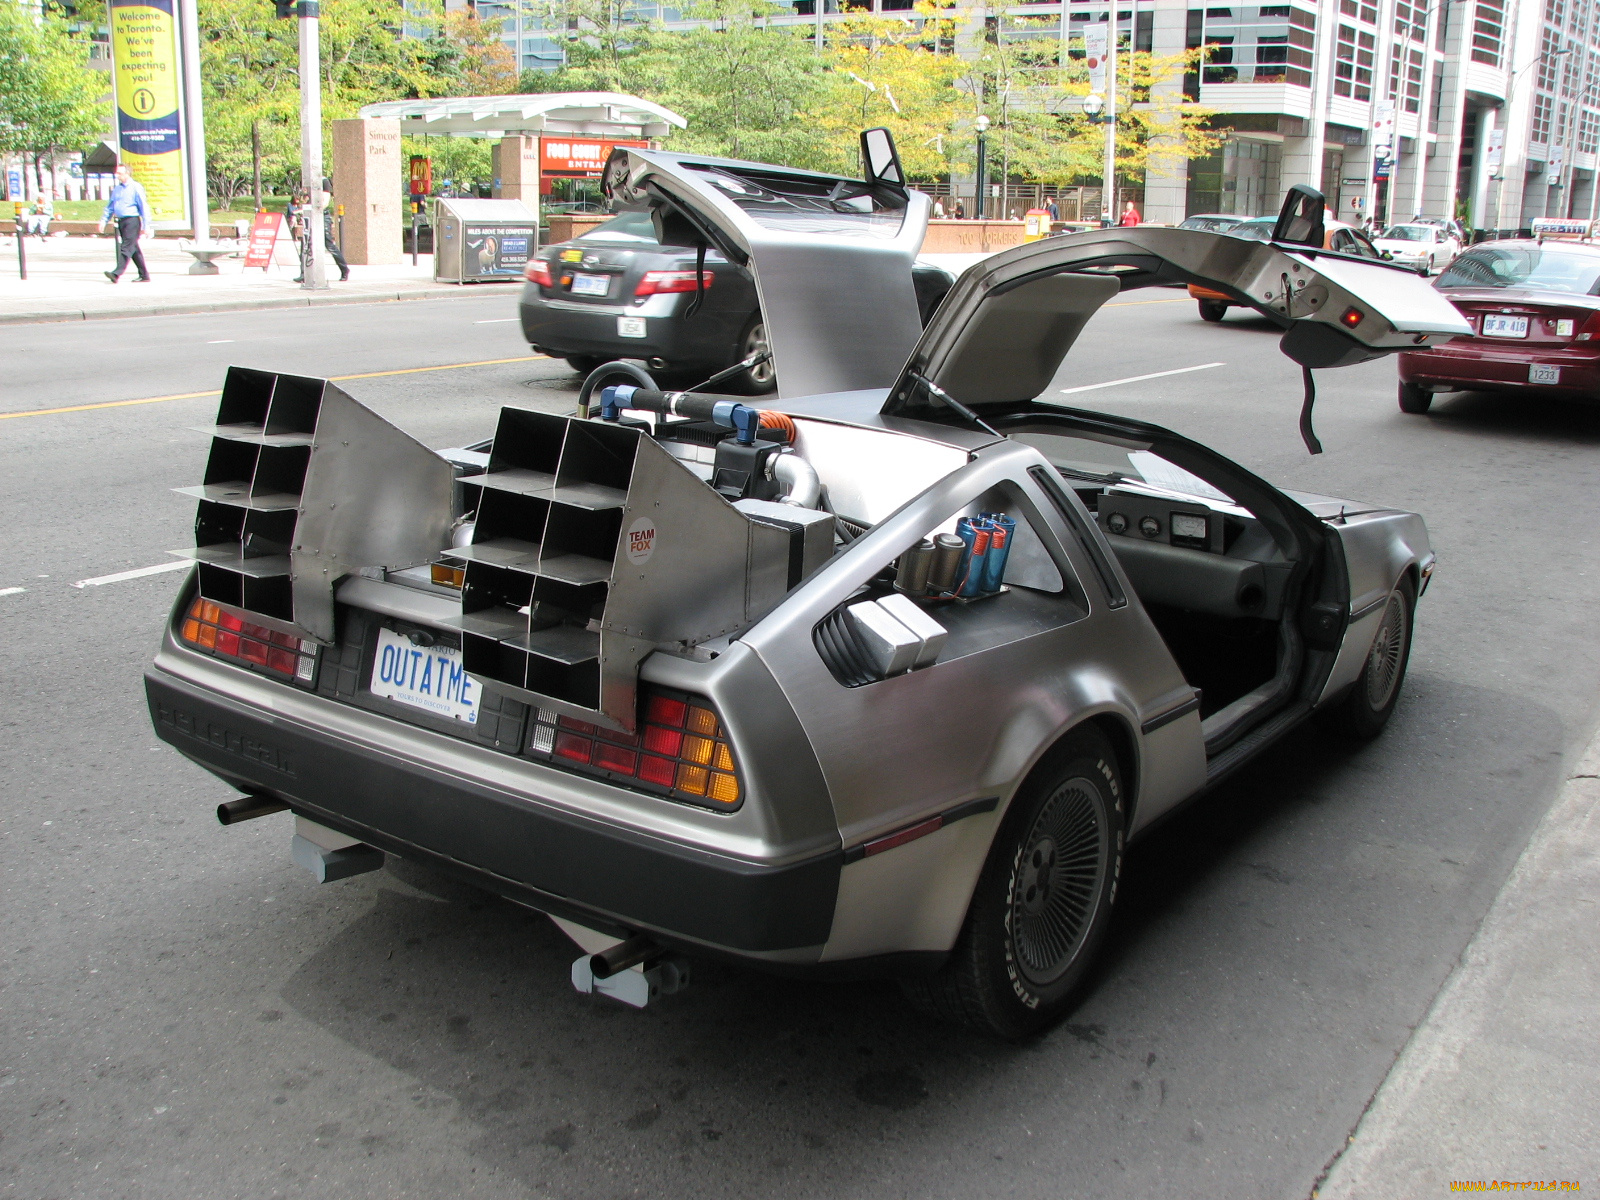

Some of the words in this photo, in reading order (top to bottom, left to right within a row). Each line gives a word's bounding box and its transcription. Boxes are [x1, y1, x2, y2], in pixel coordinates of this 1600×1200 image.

[119, 11, 160, 21] Welcome
[116, 26, 124, 34] to
[126, 24, 166, 34] Toronto.
[125, 36, 155, 46] We've
[129, 48, 153, 58] been
[121, 60, 166, 73] expecting
[132, 73, 153, 85] you!
[369, 130, 398, 141] Simcoe
[369, 145, 387, 155] Park
[546, 143, 570, 159] FOOD
[571, 143, 602, 160] COURT
[1534, 225, 1587, 234] 233-1111
[978, 231, 1018, 245] WORKERS
[1485, 319, 1506, 331] BFJR
[1509, 321, 1526, 332] 418
[1533, 369, 1555, 381] 1233
[629, 528, 655, 542] TEAM
[630, 540, 651, 552] FOX
[380, 644, 473, 706] OUTATME
[397, 691, 415, 703] YOURS
[414, 695, 423, 704] TO
[423, 699, 451, 712] DISCOVER
[1096, 758, 1122, 813] INDY
[1004, 841, 1040, 1010] FIREHAWK
